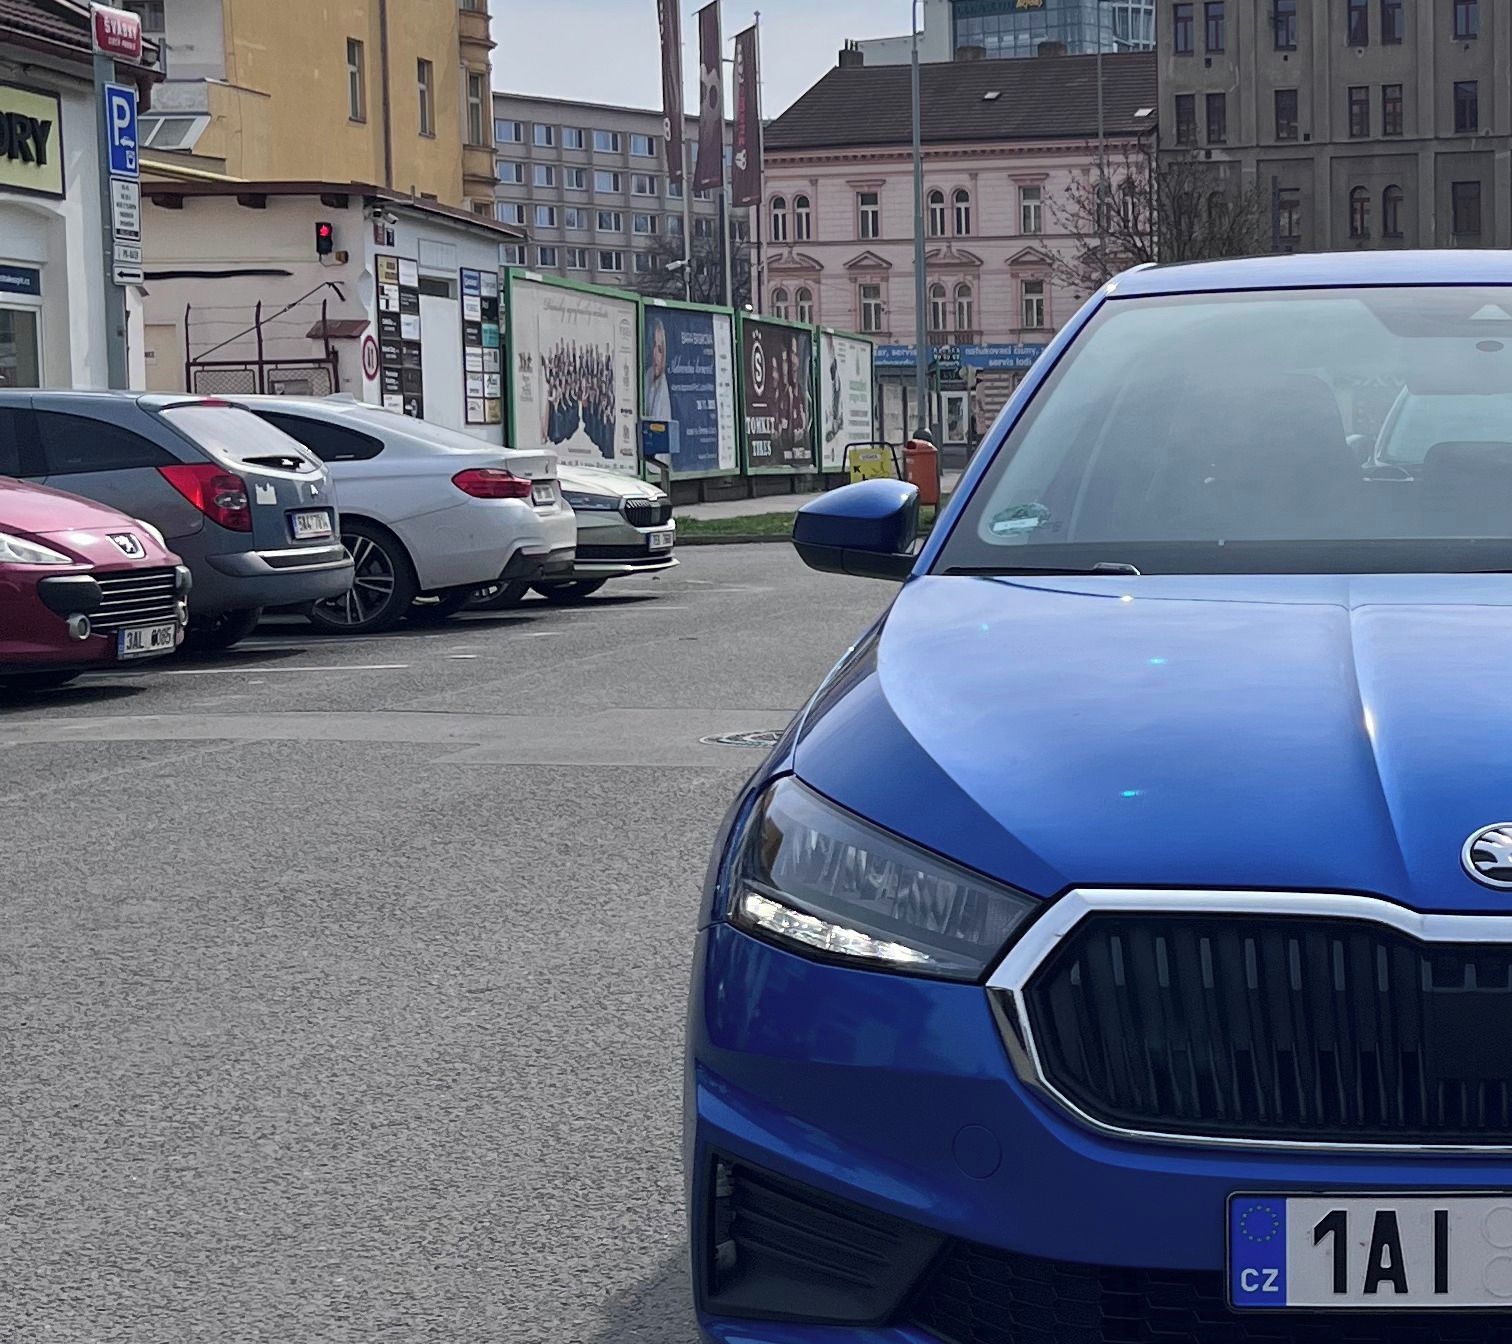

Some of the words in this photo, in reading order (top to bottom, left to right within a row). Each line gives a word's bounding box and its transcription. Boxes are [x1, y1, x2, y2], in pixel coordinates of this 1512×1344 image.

[112, 95, 130, 146] P
[1310, 1208, 1450, 1295] 1AI
[1240, 1268, 1280, 1293] CZ
